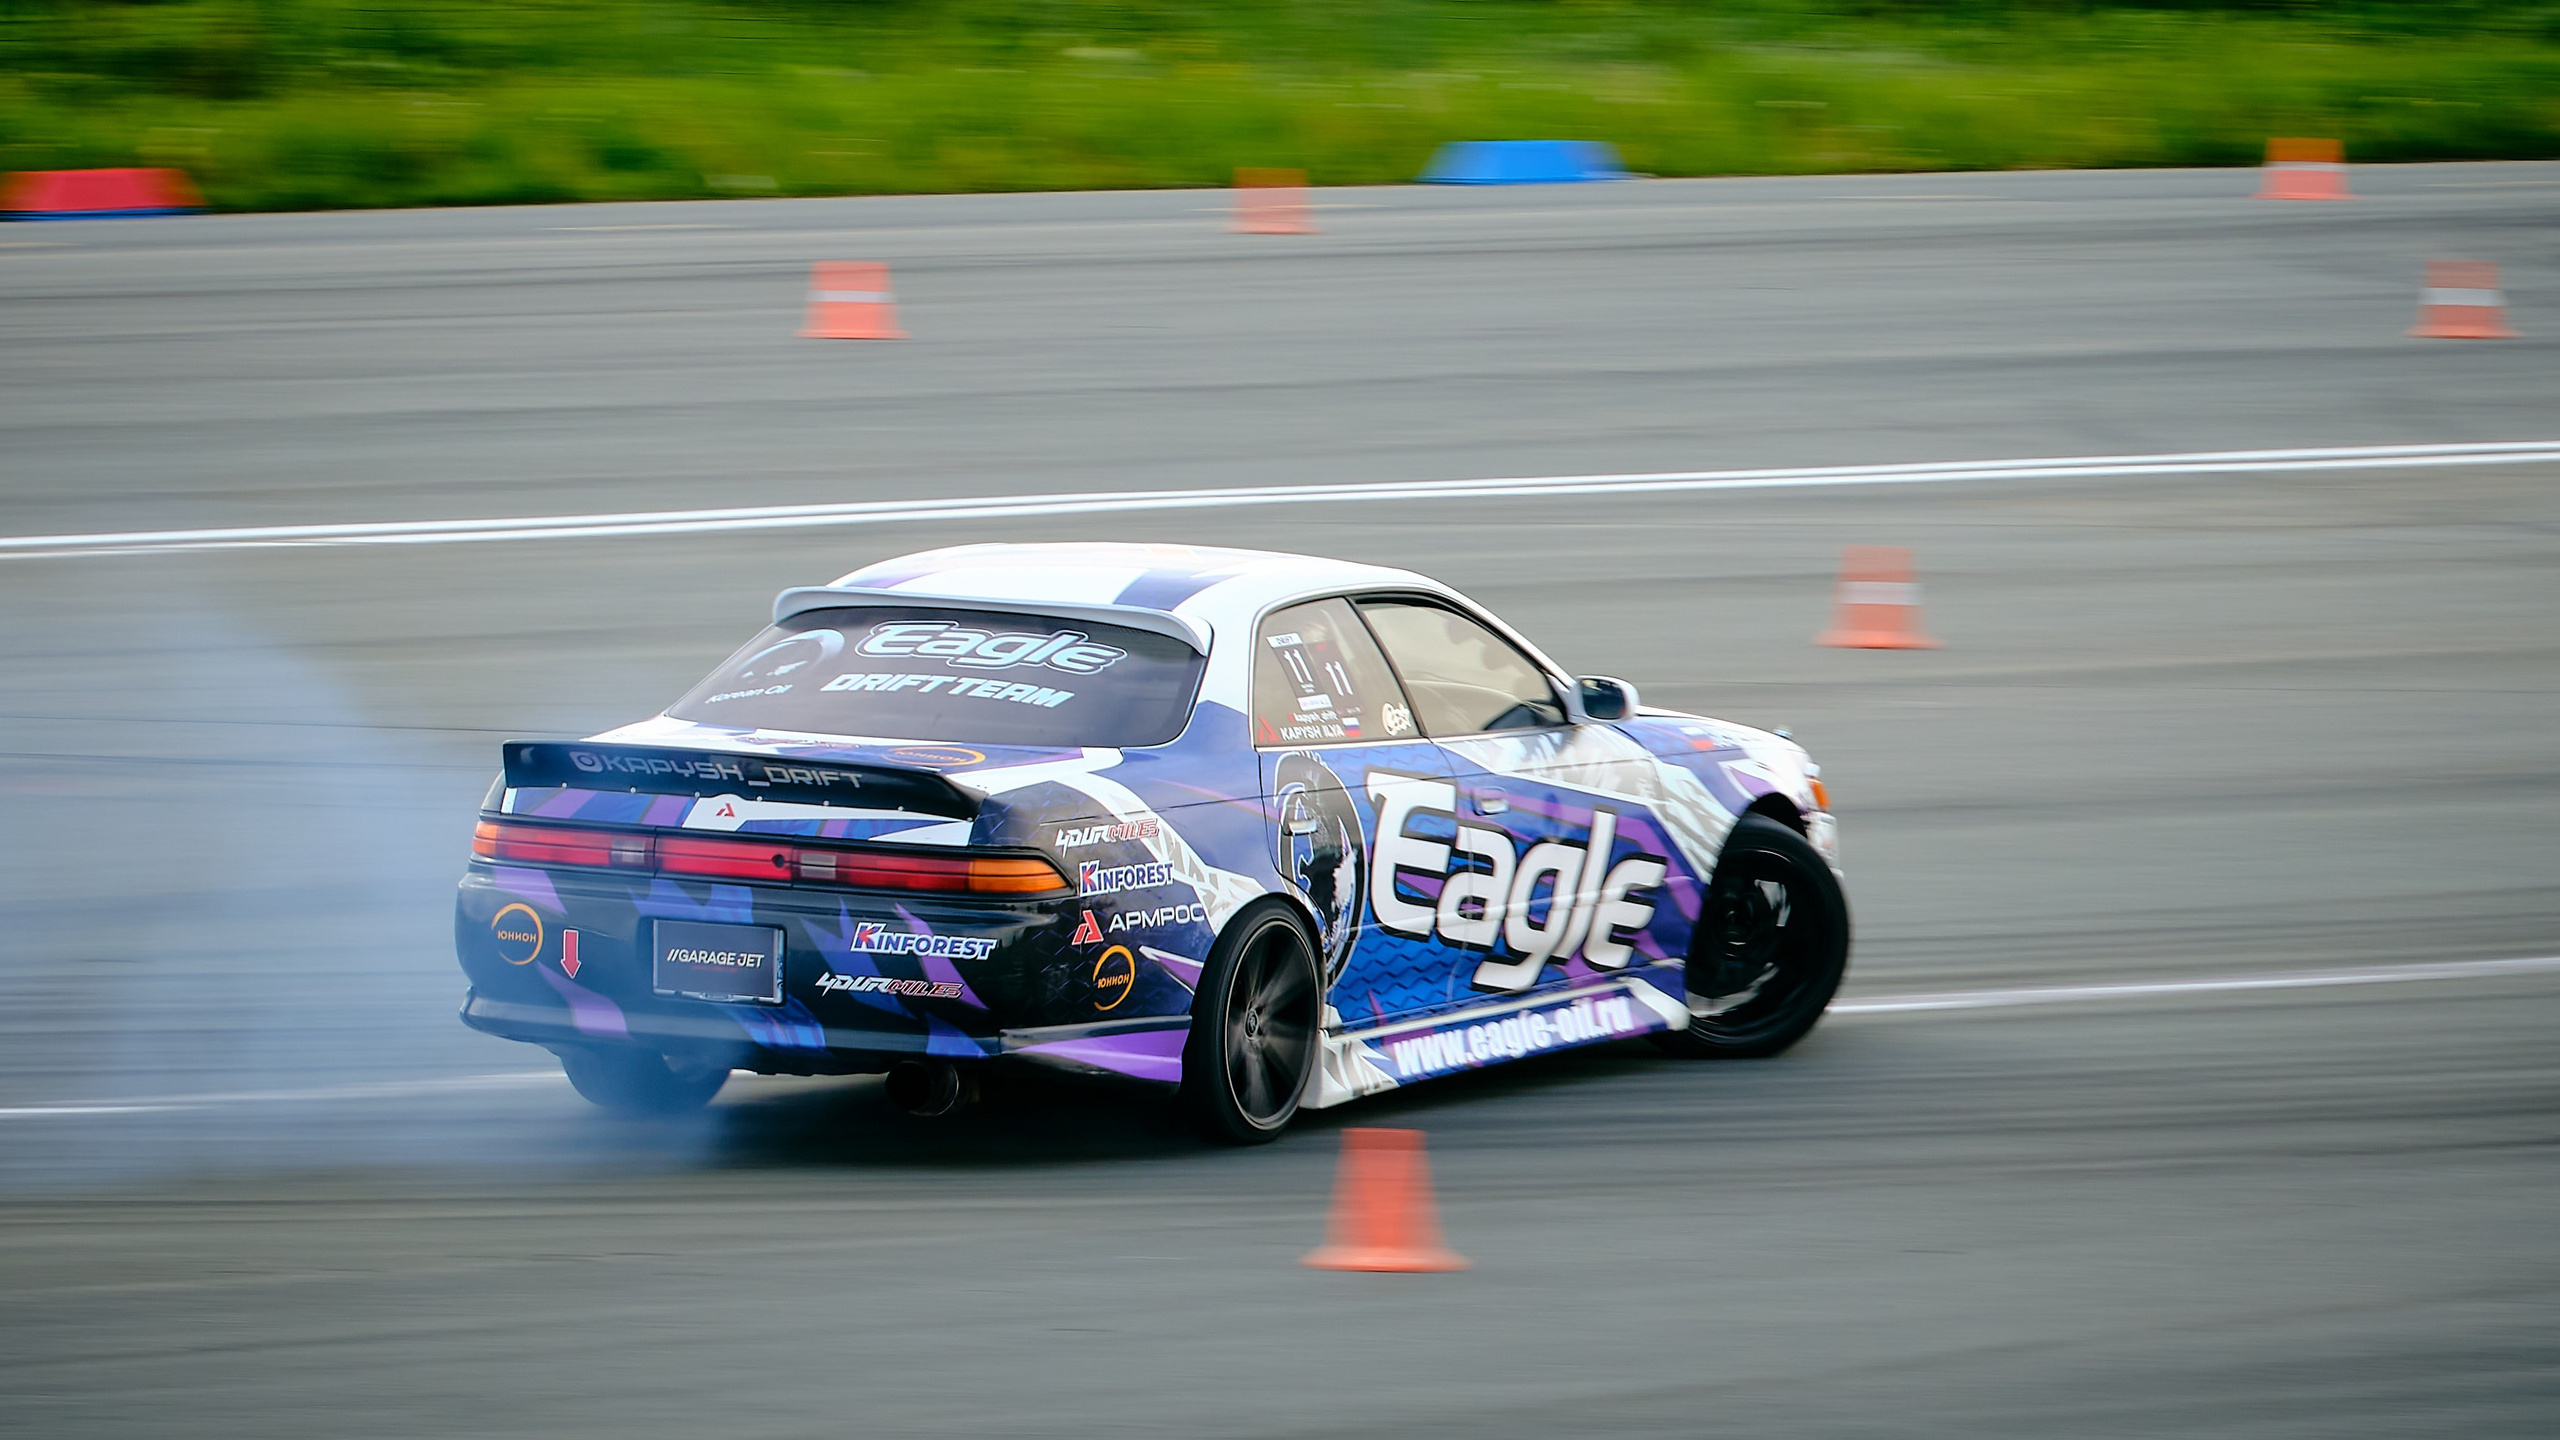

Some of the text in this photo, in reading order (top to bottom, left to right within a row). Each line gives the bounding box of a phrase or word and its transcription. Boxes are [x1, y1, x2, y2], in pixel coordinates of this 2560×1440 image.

[855, 620, 1127, 676] Eagle
[821, 672, 1075, 708] DRIFT TEAM
[1280, 724, 1345, 741] KAPYSH ILYA
[600, 753, 863, 789] KAPYSH_DRIFT
[1080, 860, 1174, 897] KINFOREST
[1368, 770, 1668, 993] Eagle
[851, 922, 997, 960] KINFOREST
[737, 953, 764, 968] JET
[1393, 996, 1635, 1077] www.eagle-oil.ru
